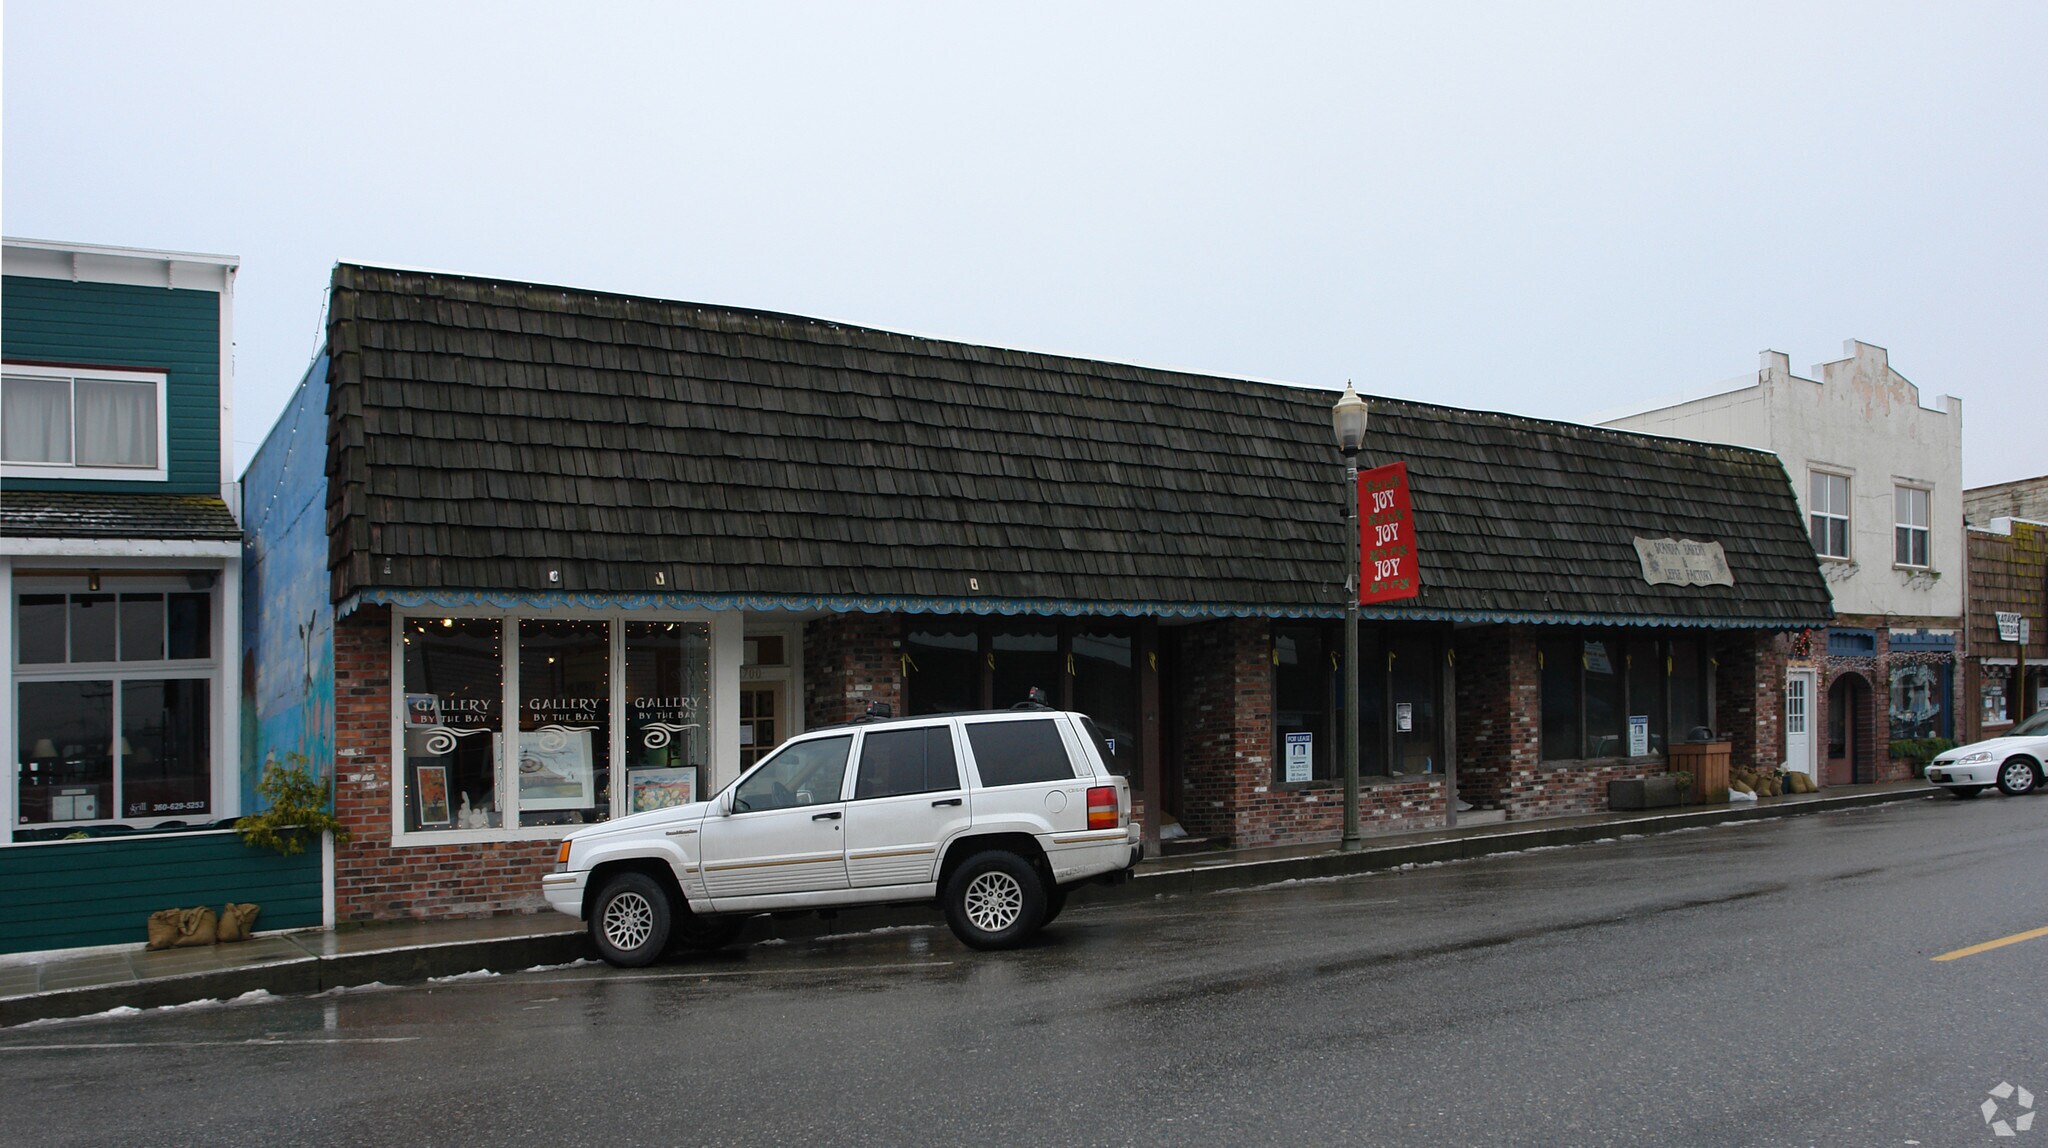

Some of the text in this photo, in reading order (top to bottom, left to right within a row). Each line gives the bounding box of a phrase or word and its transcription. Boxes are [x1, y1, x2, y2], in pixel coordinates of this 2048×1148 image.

[1372, 490, 1395, 513] JOY
[1375, 523, 1399, 546] JOY
[1374, 558, 1401, 581] JOY
[1685, 569, 1713, 582] FACTORY
[416, 699, 492, 714] GALLERY
[529, 698, 600, 713] GALLERY
[634, 697, 700, 711] GALLERY
[420, 714, 488, 723] BY THE BAY
[533, 713, 597, 722] BY THE BAY
[639, 711, 698, 720] BY THE BAY
